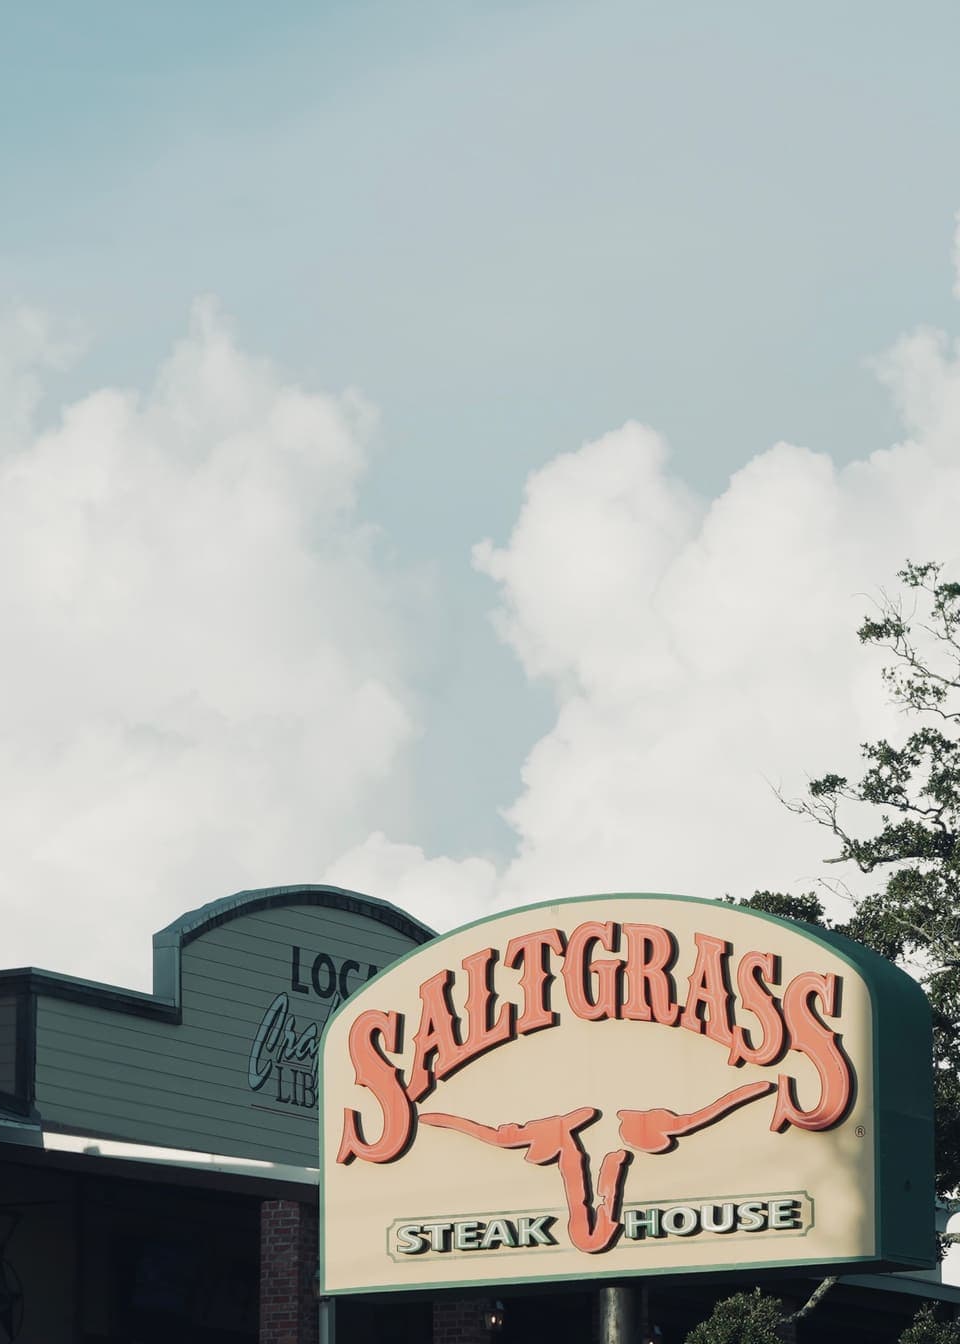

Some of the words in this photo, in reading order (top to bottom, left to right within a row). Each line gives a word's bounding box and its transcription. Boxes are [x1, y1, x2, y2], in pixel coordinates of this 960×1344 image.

[291, 945, 378, 1000] LOC
[336, 920, 856, 1165] SALTGRASS
[275, 1064, 319, 1110] LIB
[396, 1215, 558, 1258] STEAK
[624, 1199, 807, 1240] HOUSE
